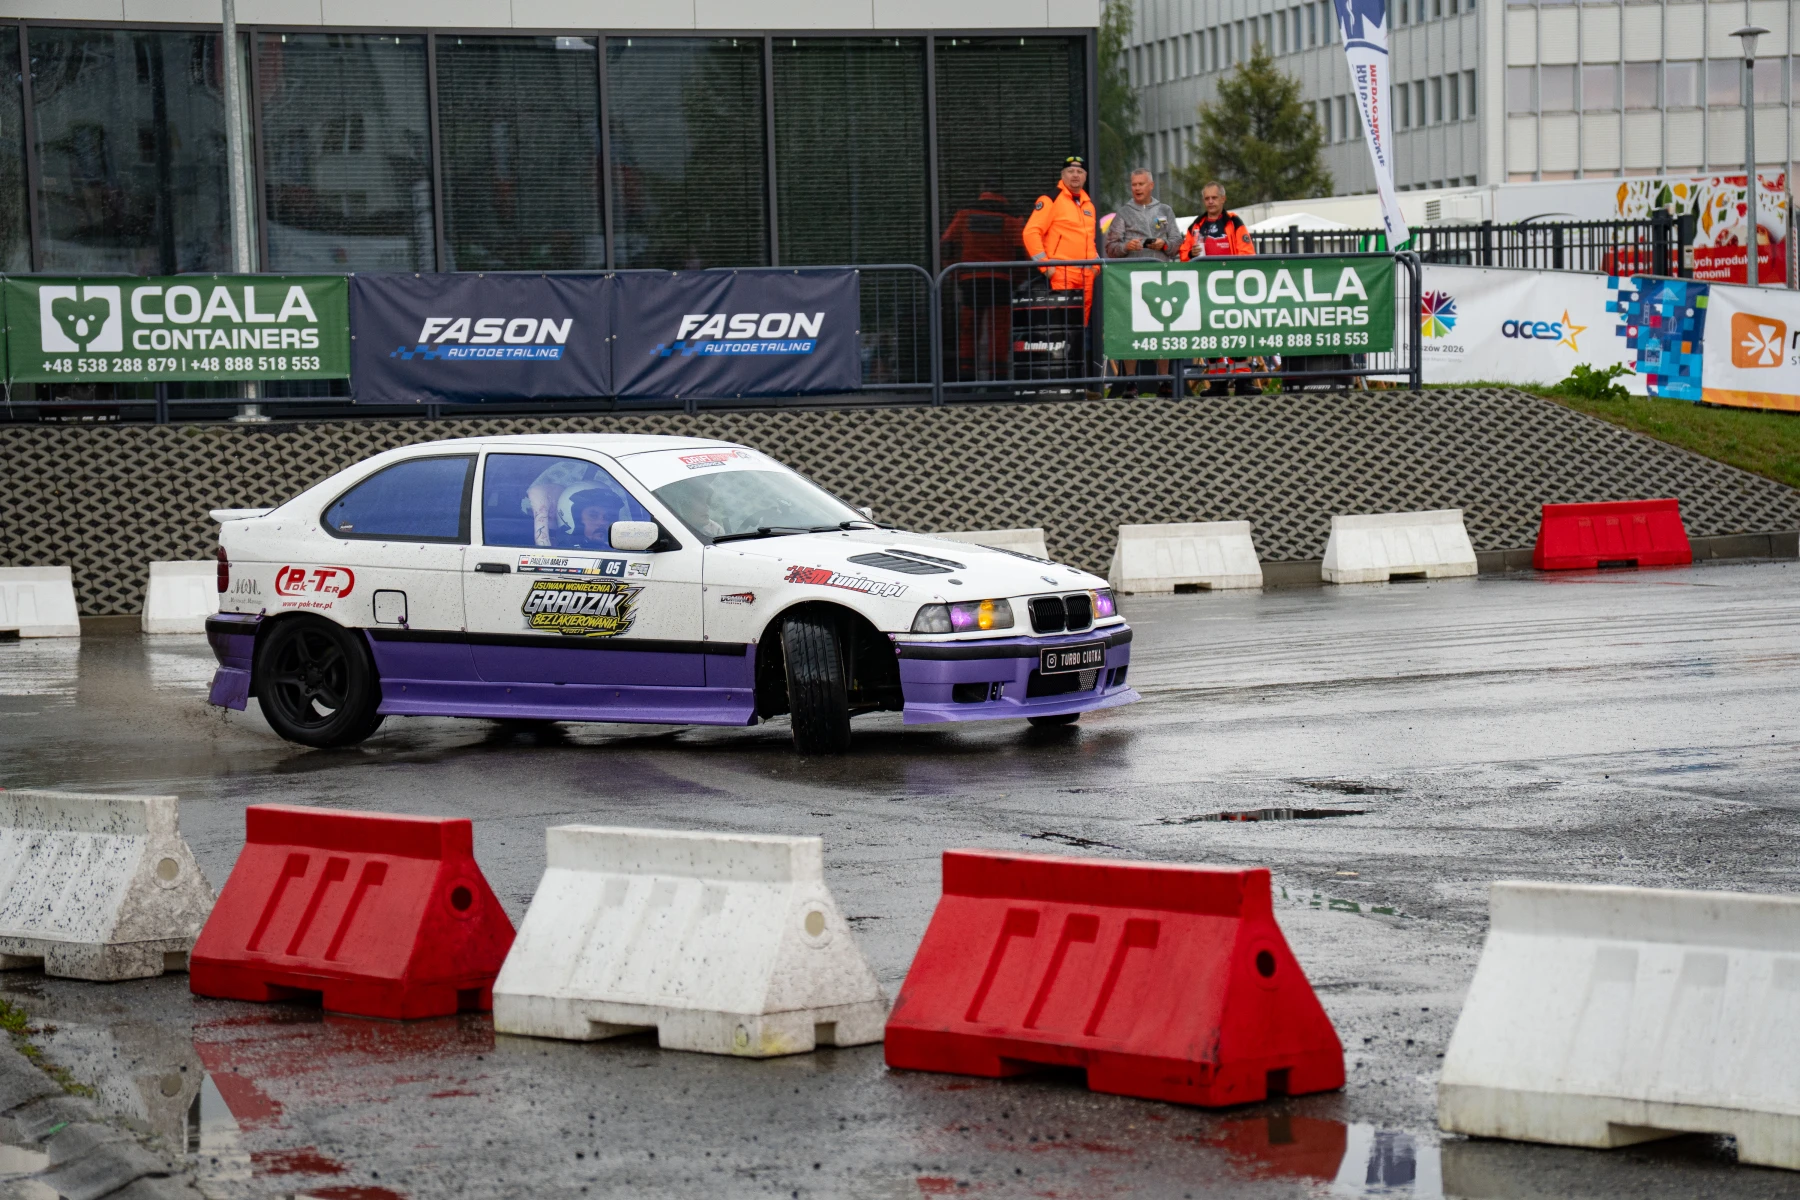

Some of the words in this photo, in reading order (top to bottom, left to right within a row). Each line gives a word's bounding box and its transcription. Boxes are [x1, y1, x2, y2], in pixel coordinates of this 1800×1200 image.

[1714, 255, 1769, 268] produkw
[1206, 267, 1368, 304] COALA
[130, 285, 318, 324] COALA
[676, 312, 825, 340] FASON
[1209, 306, 1369, 329] CONTAINERS
[418, 317, 573, 344] FASON
[1501, 319, 1563, 341] aces
[132, 328, 320, 350] CONTAINERS
[704, 342, 811, 352] AUTODETAILING
[1132, 338, 1158, 350] +48
[1162, 337, 1188, 349] 538
[1191, 336, 1217, 349] 288
[1221, 335, 1247, 348] 879
[1258, 335, 1283, 347] +48
[1287, 334, 1312, 346] 888
[1316, 333, 1341, 346] 518
[1344, 332, 1369, 345] 553
[447, 348, 559, 357] AUTODETAILING
[1403, 343, 1441, 353] Rzów
[1442, 344, 1465, 354] 2026
[42, 359, 73, 373] +48
[77, 358, 107, 372] 538
[112, 358, 142, 372] 288
[148, 357, 177, 372] 879
[191, 357, 220, 371] +48
[225, 357, 254, 371] 888
[258, 356, 287, 370] 518
[291, 356, 320, 370] 553
[605, 561, 621, 575] 05
[533, 581, 565, 591] USUWAM
[565, 583, 611, 592] WGNIECENIA
[523, 590, 624, 617] GRADZIK
[533, 613, 553, 625] BEZ
[552, 614, 618, 630] LAKIEROWANIA
[1061, 652, 1081, 667] TURBO
